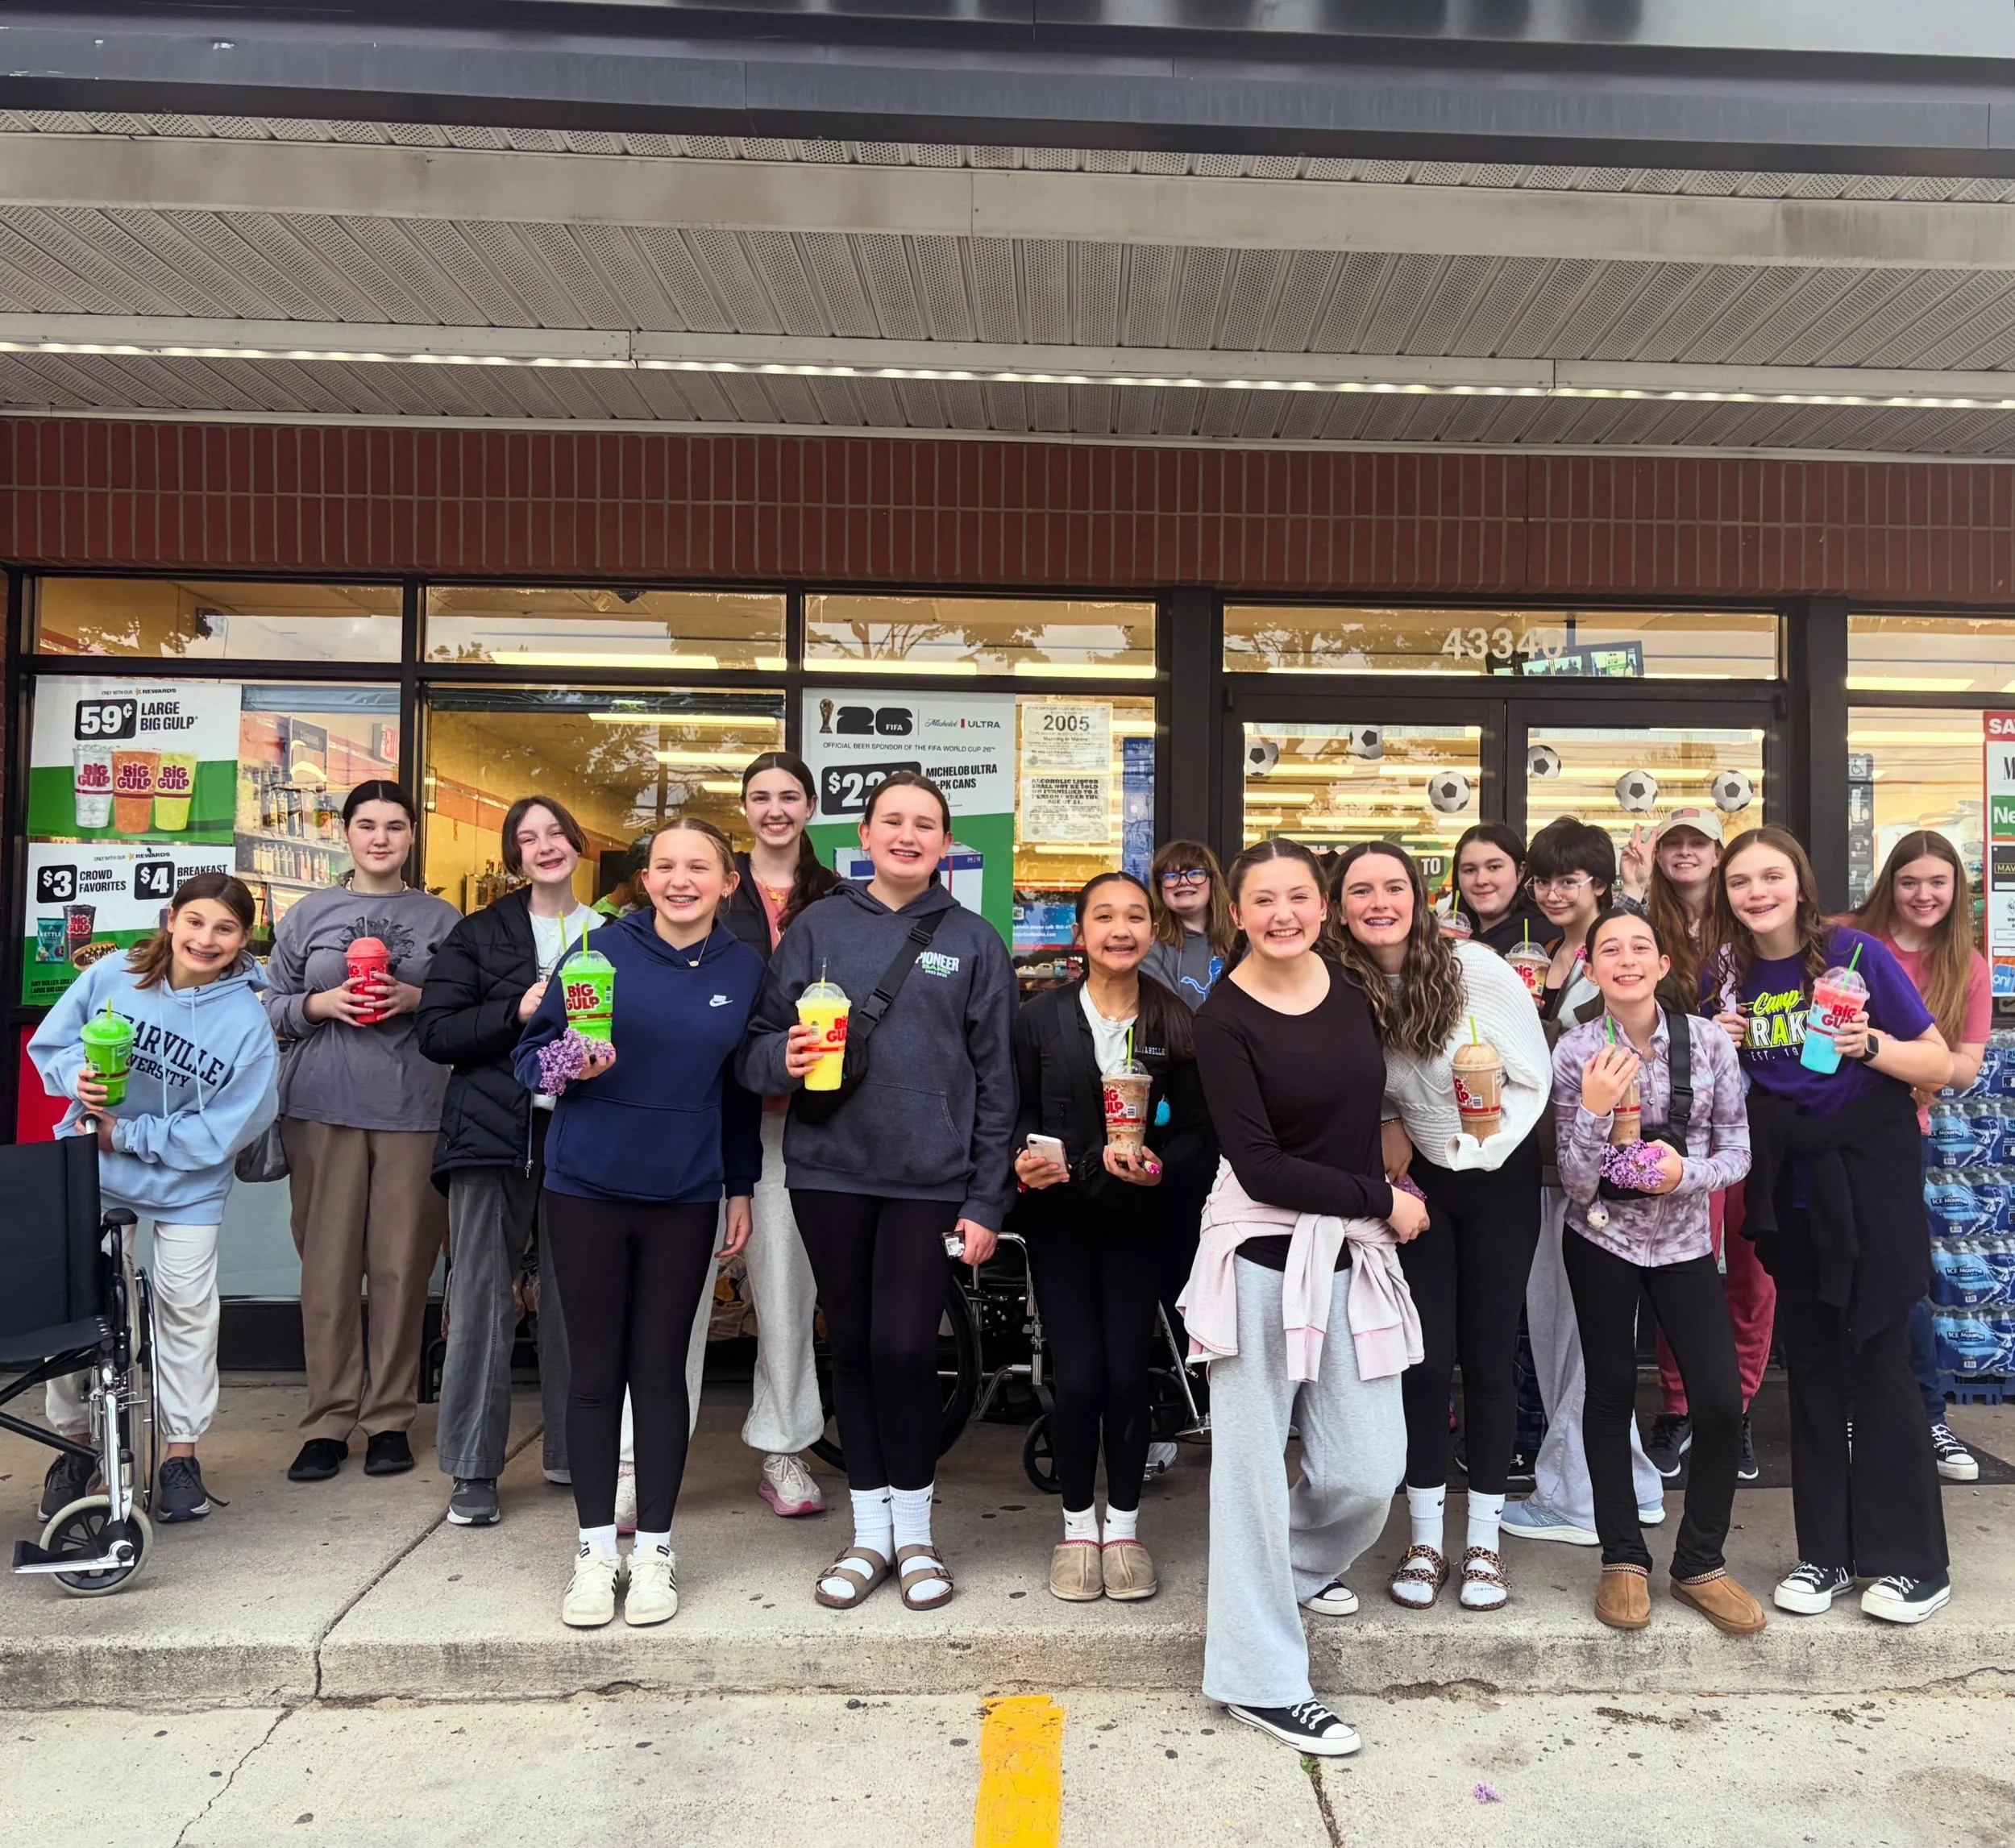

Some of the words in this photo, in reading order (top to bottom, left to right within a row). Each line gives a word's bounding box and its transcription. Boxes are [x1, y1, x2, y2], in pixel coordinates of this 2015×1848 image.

[1441, 627, 1564, 659] 43340
[141, 702, 180, 716] LARGE
[80, 703, 133, 734] 59¢
[140, 717, 161, 731] BIG
[967, 721, 1001, 729] ULTRA
[1043, 715, 1090, 732] 2005
[1988, 718, 2015, 734] SA
[926, 766, 970, 778] MICHELOB
[970, 764, 997, 774] ULTRA
[77, 775, 110, 787] GULP
[117, 777, 152, 790] GULP
[157, 778, 189, 790] GULP
[953, 778, 977, 789] CANS
[177, 864, 227, 877] BREAKFAST
[1421, 857, 1441, 875] TO
[79, 870, 113, 881] CROWD
[140, 866, 170, 894] $4
[43, 870, 72, 897] $3
[79, 880, 127, 893] FAVORITES
[1515, 965, 1533, 978] iG
[566, 996, 600, 1011] GULP
[1753, 990, 1801, 1015] Camp
[1745, 1011, 1810, 1049] RAK
[96, 1008, 225, 1086] ARVILLE
[1751, 1051, 1775, 1061] EST.
[126, 1053, 192, 1088] VERSITY
